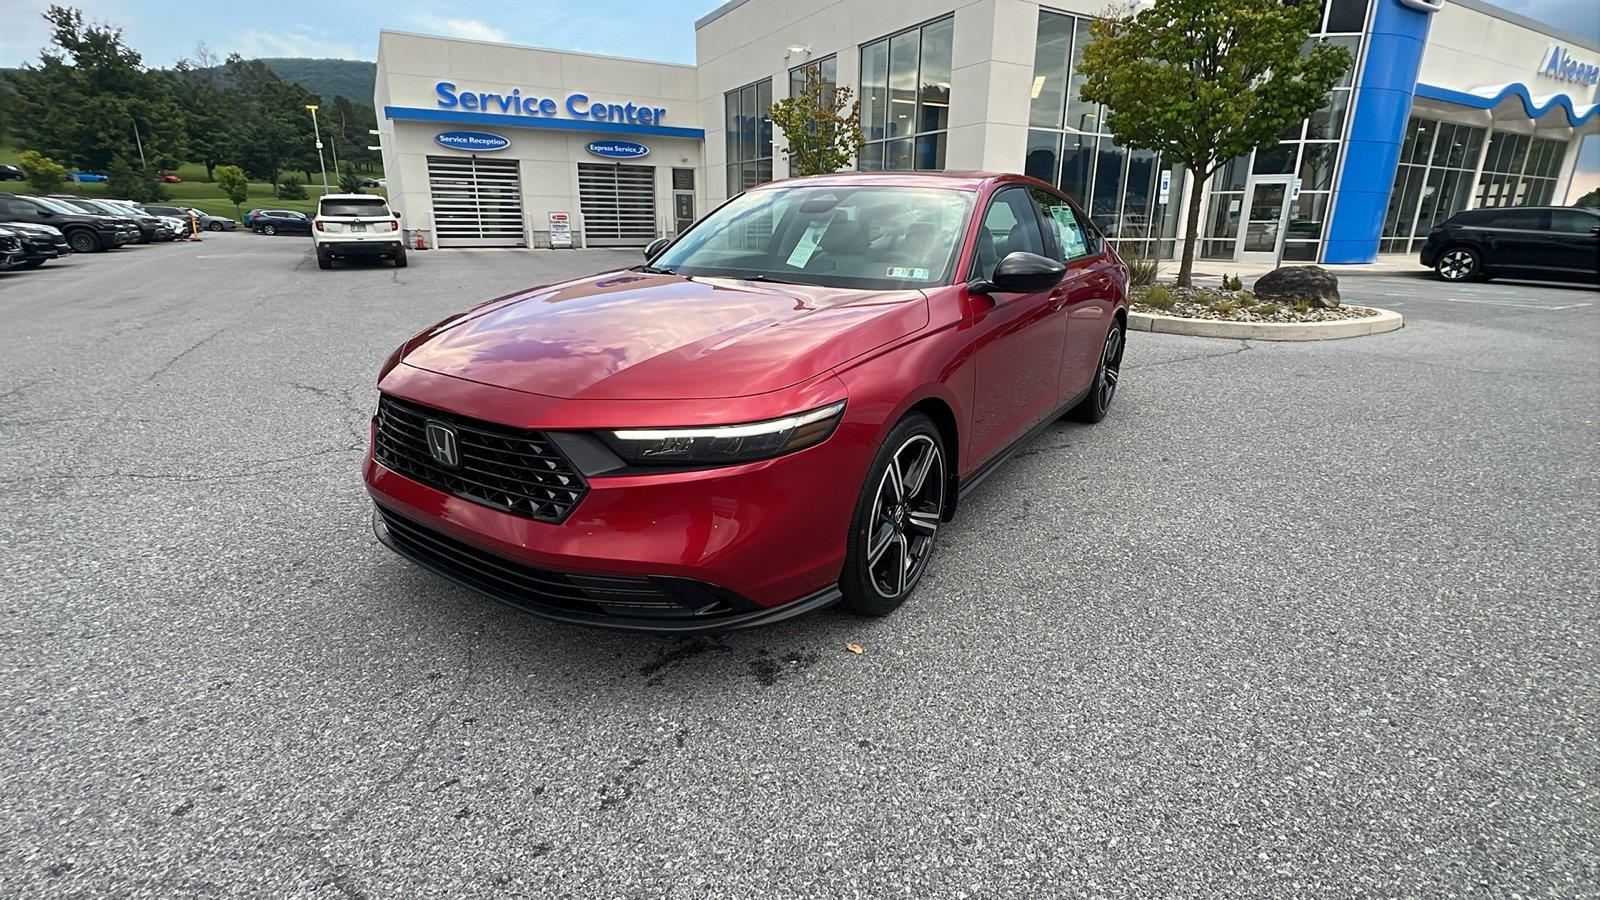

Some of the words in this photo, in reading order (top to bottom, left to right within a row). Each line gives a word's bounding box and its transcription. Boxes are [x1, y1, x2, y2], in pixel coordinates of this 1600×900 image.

[435, 81, 557, 116] Service
[565, 93, 667, 126] Center
[439, 135, 467, 144] Service
[468, 136, 506, 146] Reception
[589, 144, 614, 152] Express
[614, 145, 637, 153] Service
